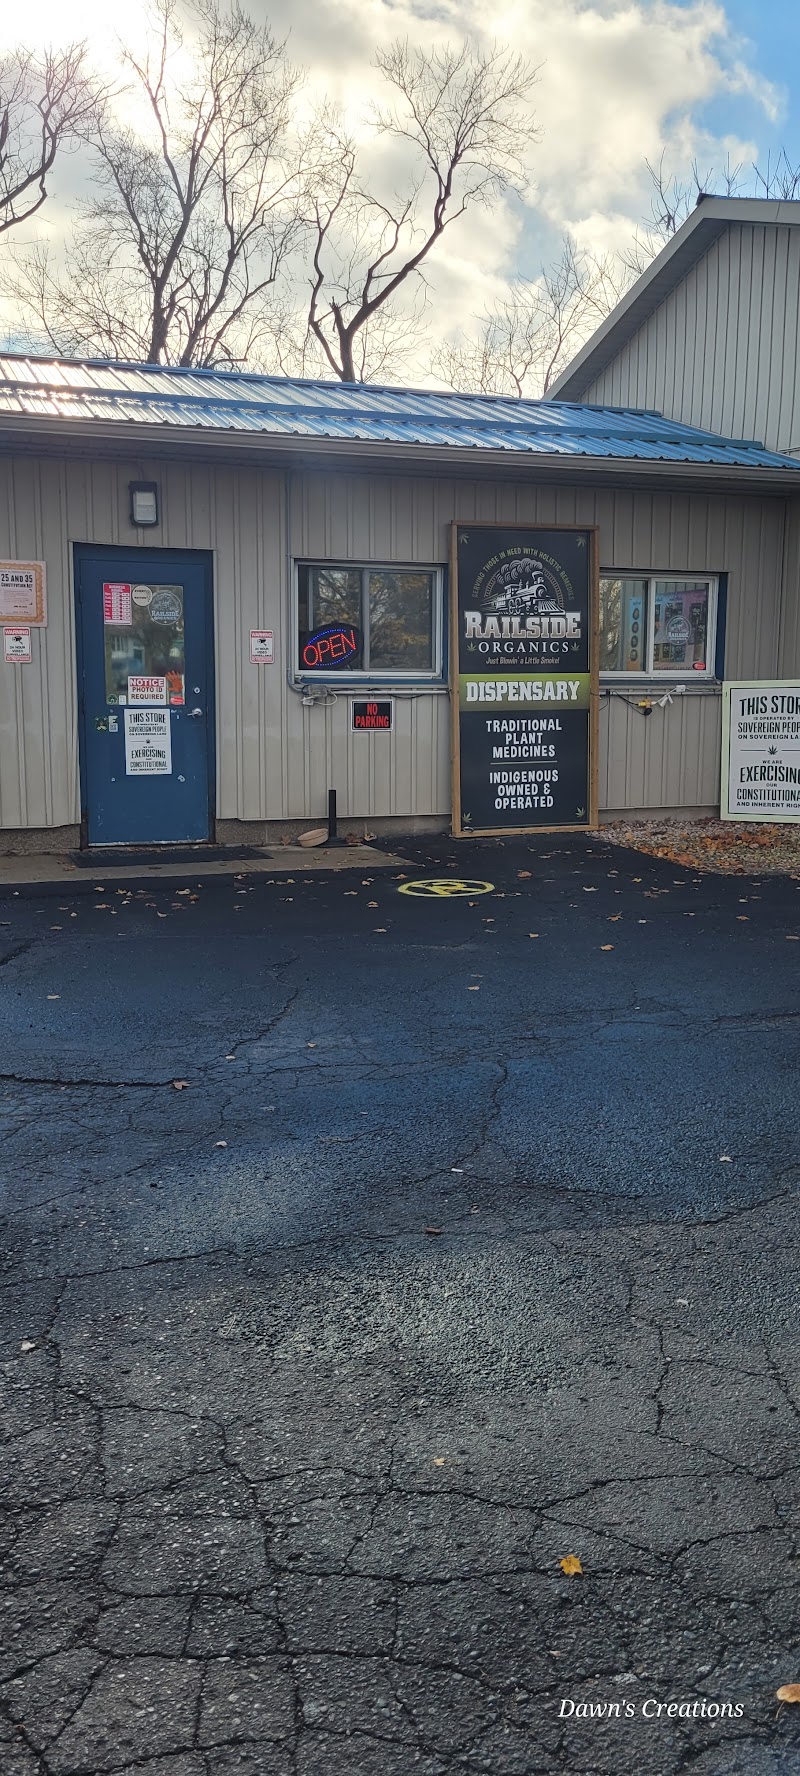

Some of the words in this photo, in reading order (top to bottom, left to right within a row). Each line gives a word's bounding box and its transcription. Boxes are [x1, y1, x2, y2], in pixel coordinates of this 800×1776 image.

[472, 572, 486, 598] SERVING
[482, 556, 499, 572] THOSE
[499, 552, 506, 560] IN
[506, 548, 522, 556] NEED
[523, 548, 538, 556] WITH
[539, 552, 562, 572] HOLISTIC
[560, 570, 574, 600] REMEDIES
[464, 611, 581, 638] RAILSIDE
[304, 630, 356, 666] OPEN
[478, 642, 569, 653] ORGANICS
[466, 681, 580, 701] DISPENSARY
[367, 704, 378, 715] NO
[739, 696, 768, 716] THIS
[771, 696, 800, 714] STOR
[129, 713, 144, 723] THIS
[146, 713, 166, 723] STORE
[355, 716, 389, 728] PARKING
[486, 719, 562, 732] TRADITIONAL
[738, 722, 780, 733] SOVEREIGN
[783, 722, 800, 732] PEOP
[505, 732, 543, 745] PLANT
[131, 749, 166, 759] EXERCISING
[493, 745, 555, 758] MEDICINES
[490, 770, 559, 783] INDIGENOUS
[498, 784, 538, 796] OWNED
[544, 783, 550, 795] &
[737, 788, 800, 802] CONSTITUTIONA
[494, 796, 554, 809] OPERATED
